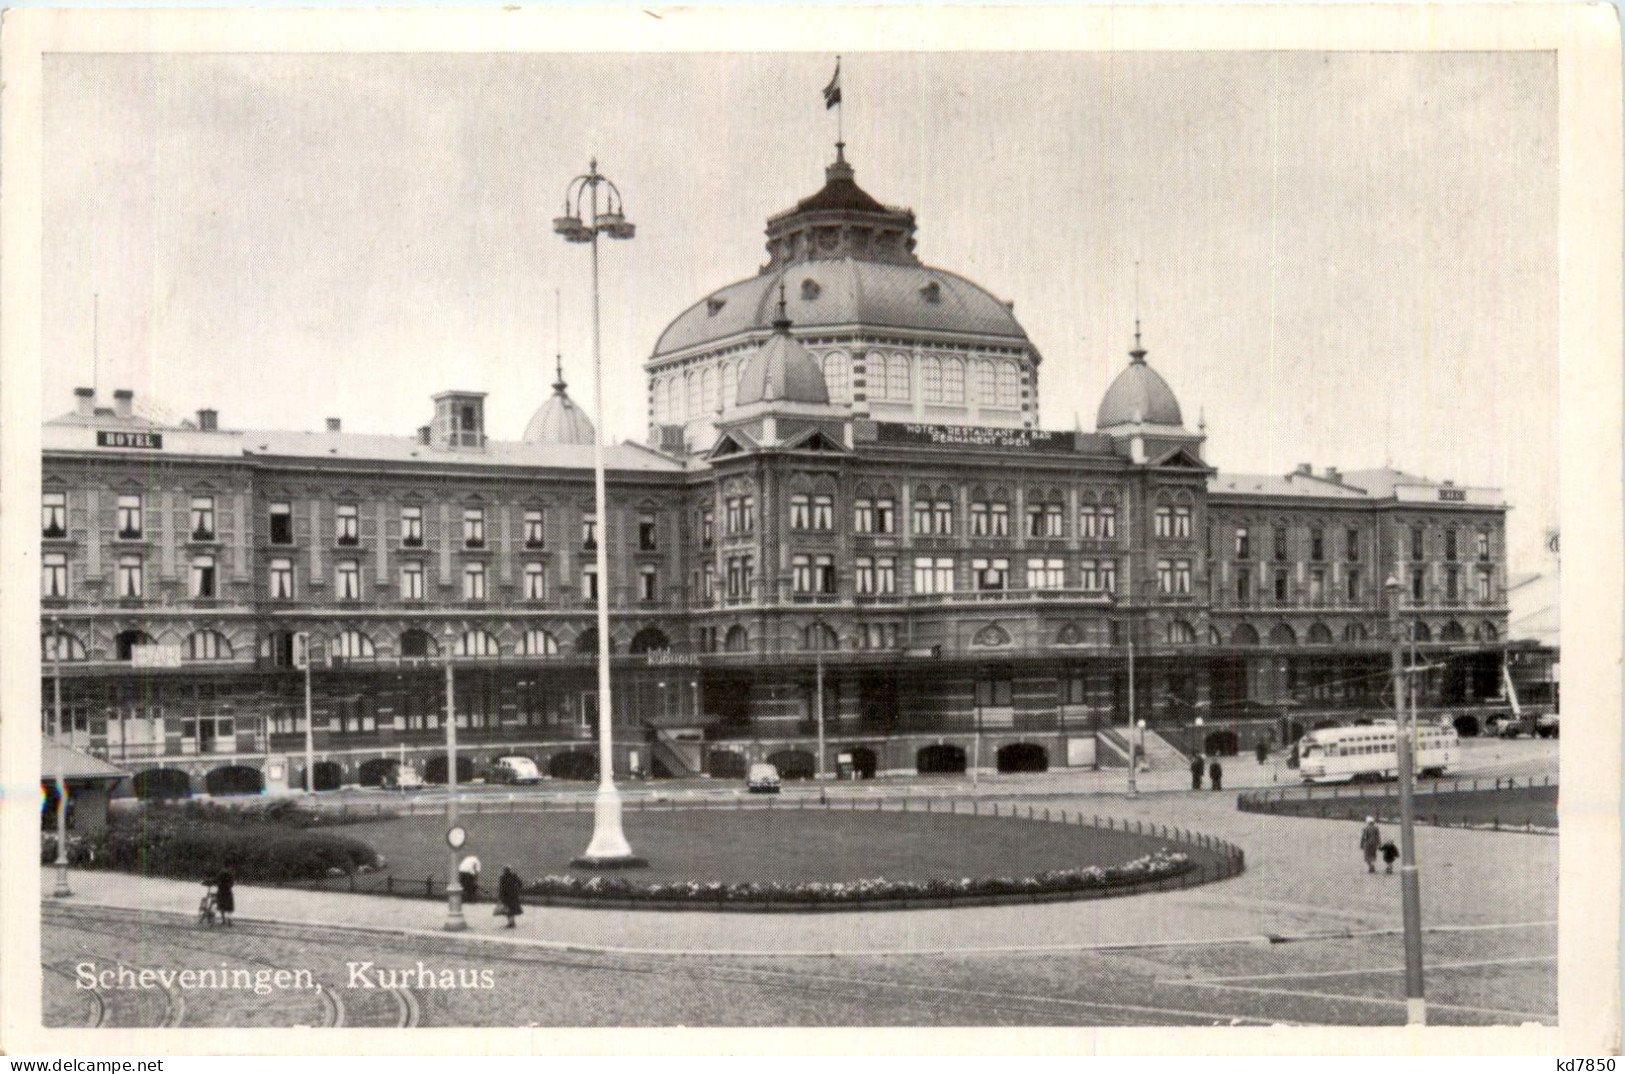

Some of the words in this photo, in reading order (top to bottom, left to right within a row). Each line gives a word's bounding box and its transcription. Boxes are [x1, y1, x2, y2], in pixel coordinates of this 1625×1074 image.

[106, 432, 154, 447] HOTEL
[907, 425, 940, 438] HOTEL
[948, 426, 1014, 438] RESTAURANT
[1032, 431, 1052, 440] BAR
[931, 434, 996, 444] PERMANENT
[1001, 438, 1031, 447] OPEN
